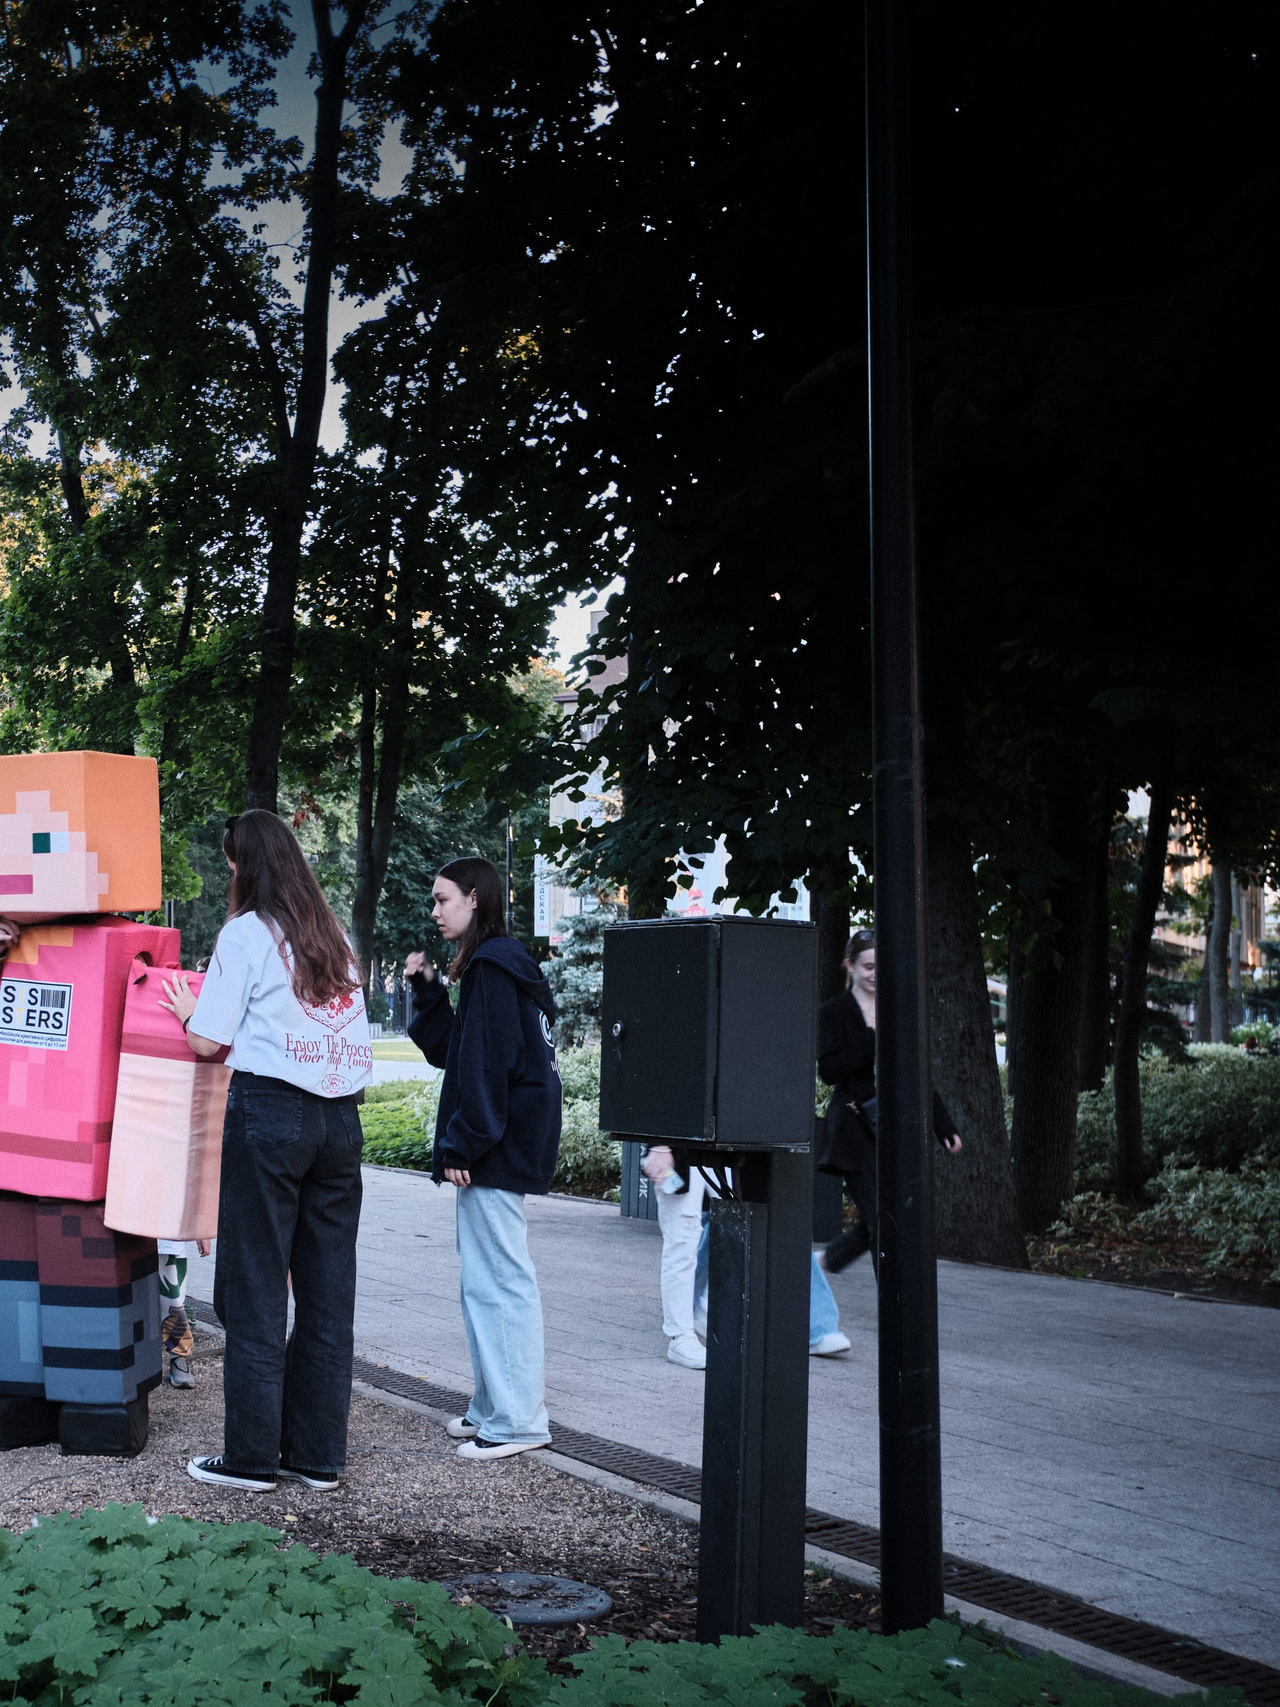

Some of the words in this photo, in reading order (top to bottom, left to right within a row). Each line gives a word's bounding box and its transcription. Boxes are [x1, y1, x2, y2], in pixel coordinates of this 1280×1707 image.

[2, 985, 38, 1006] SIS
[1, 1006, 64, 1030] STERS
[285, 1032, 321, 1056] Enjoy
[323, 1034, 339, 1055] The
[285, 1046, 324, 1063] Never
